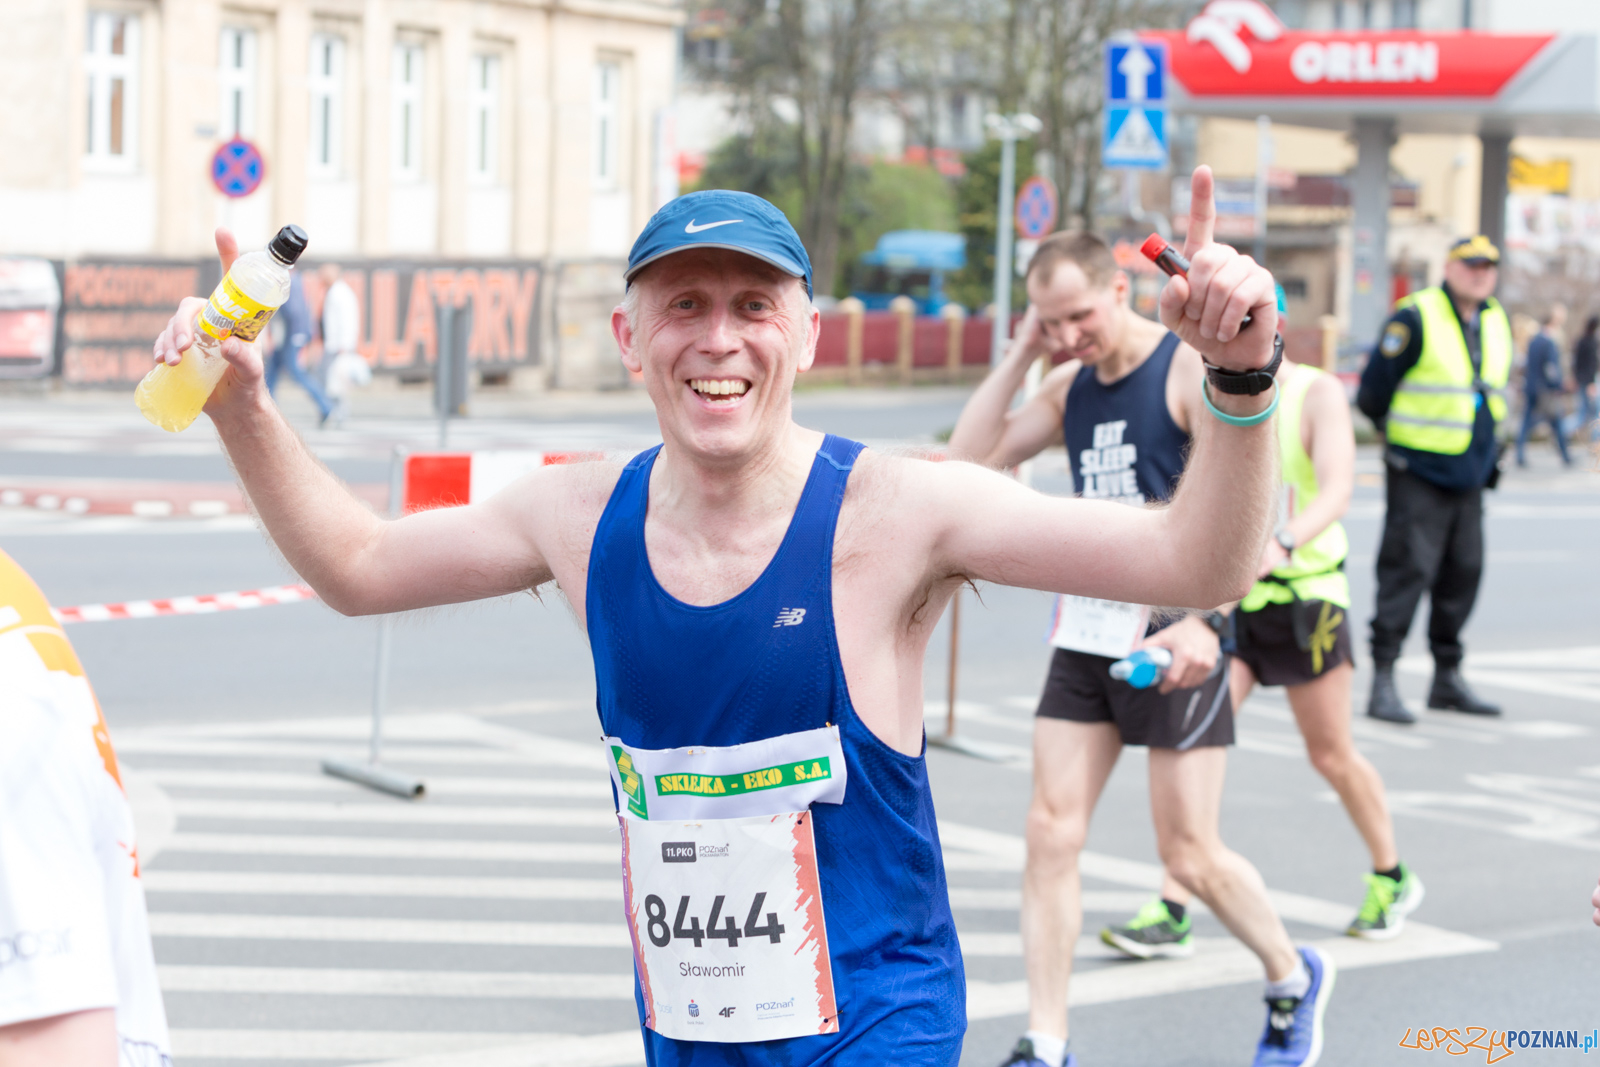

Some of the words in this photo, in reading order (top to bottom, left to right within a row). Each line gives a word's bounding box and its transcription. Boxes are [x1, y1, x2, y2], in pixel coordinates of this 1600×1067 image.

[1290, 42, 1439, 83] ORLEN
[1093, 419, 1127, 449] EAT
[1080, 443, 1137, 476] SLEEP
[743, 767, 783, 790] EKO
[794, 761, 828, 782] S.A.
[644, 891, 786, 948] 8444
[679, 961, 746, 977] Sławomir
[718, 1006, 737, 1018] 4F
